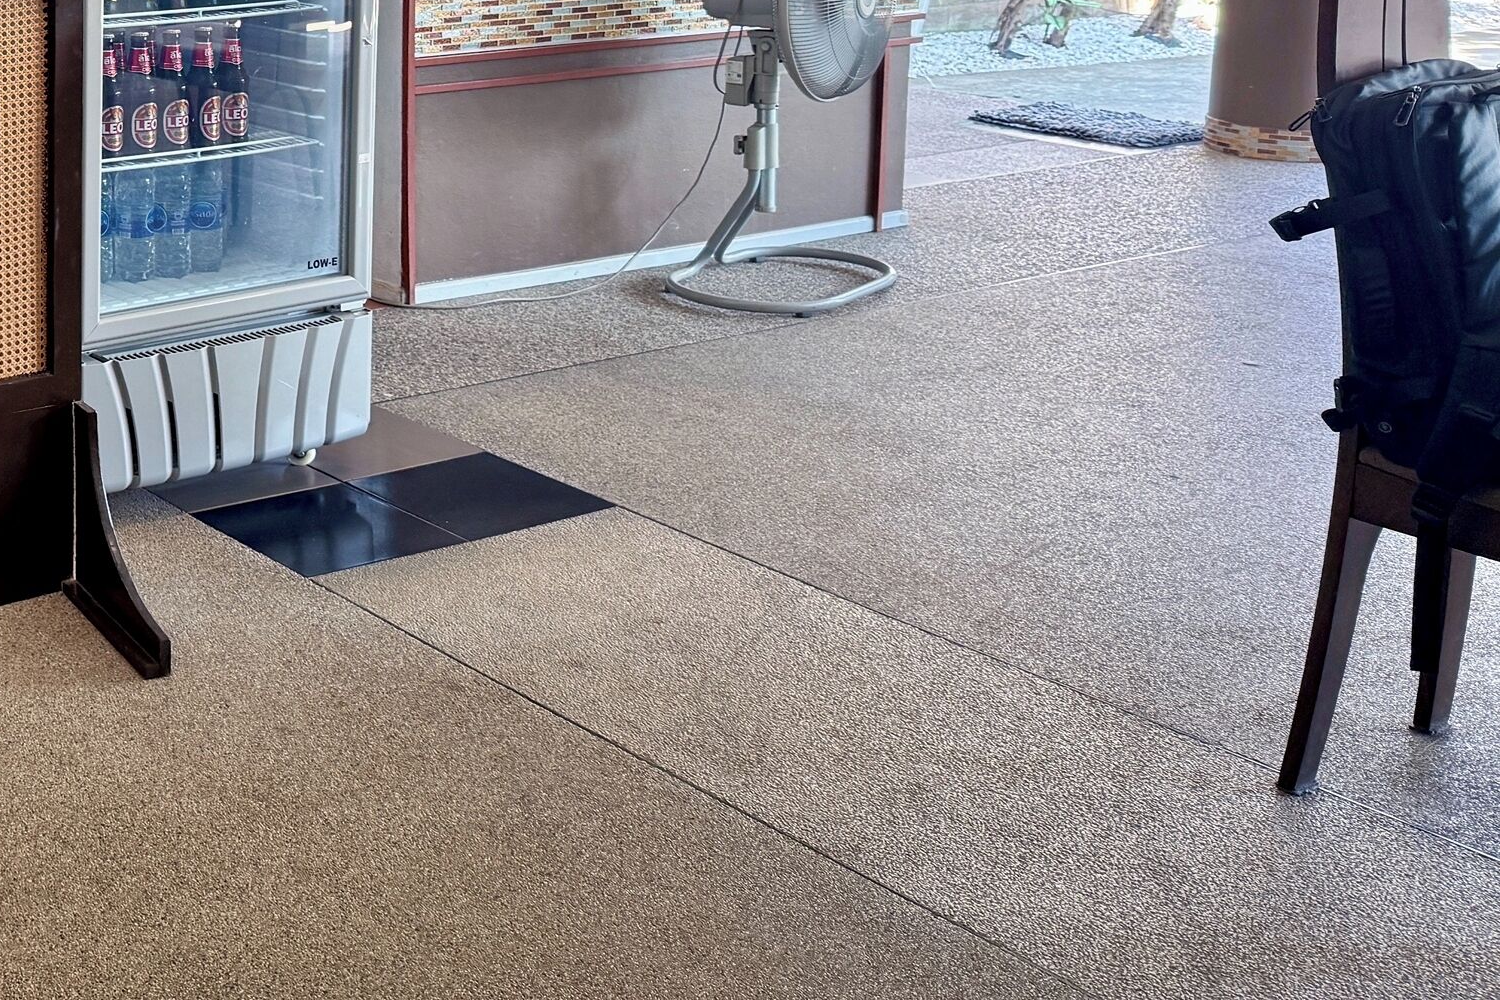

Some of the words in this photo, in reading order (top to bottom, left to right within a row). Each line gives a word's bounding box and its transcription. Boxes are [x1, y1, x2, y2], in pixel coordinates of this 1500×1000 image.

[225, 108, 248, 120] LEO
[135, 119, 158, 131] LEO
[167, 115, 189, 128] LEO
[103, 122, 124, 134] LEO
[307, 257, 338, 270] LOW-E
